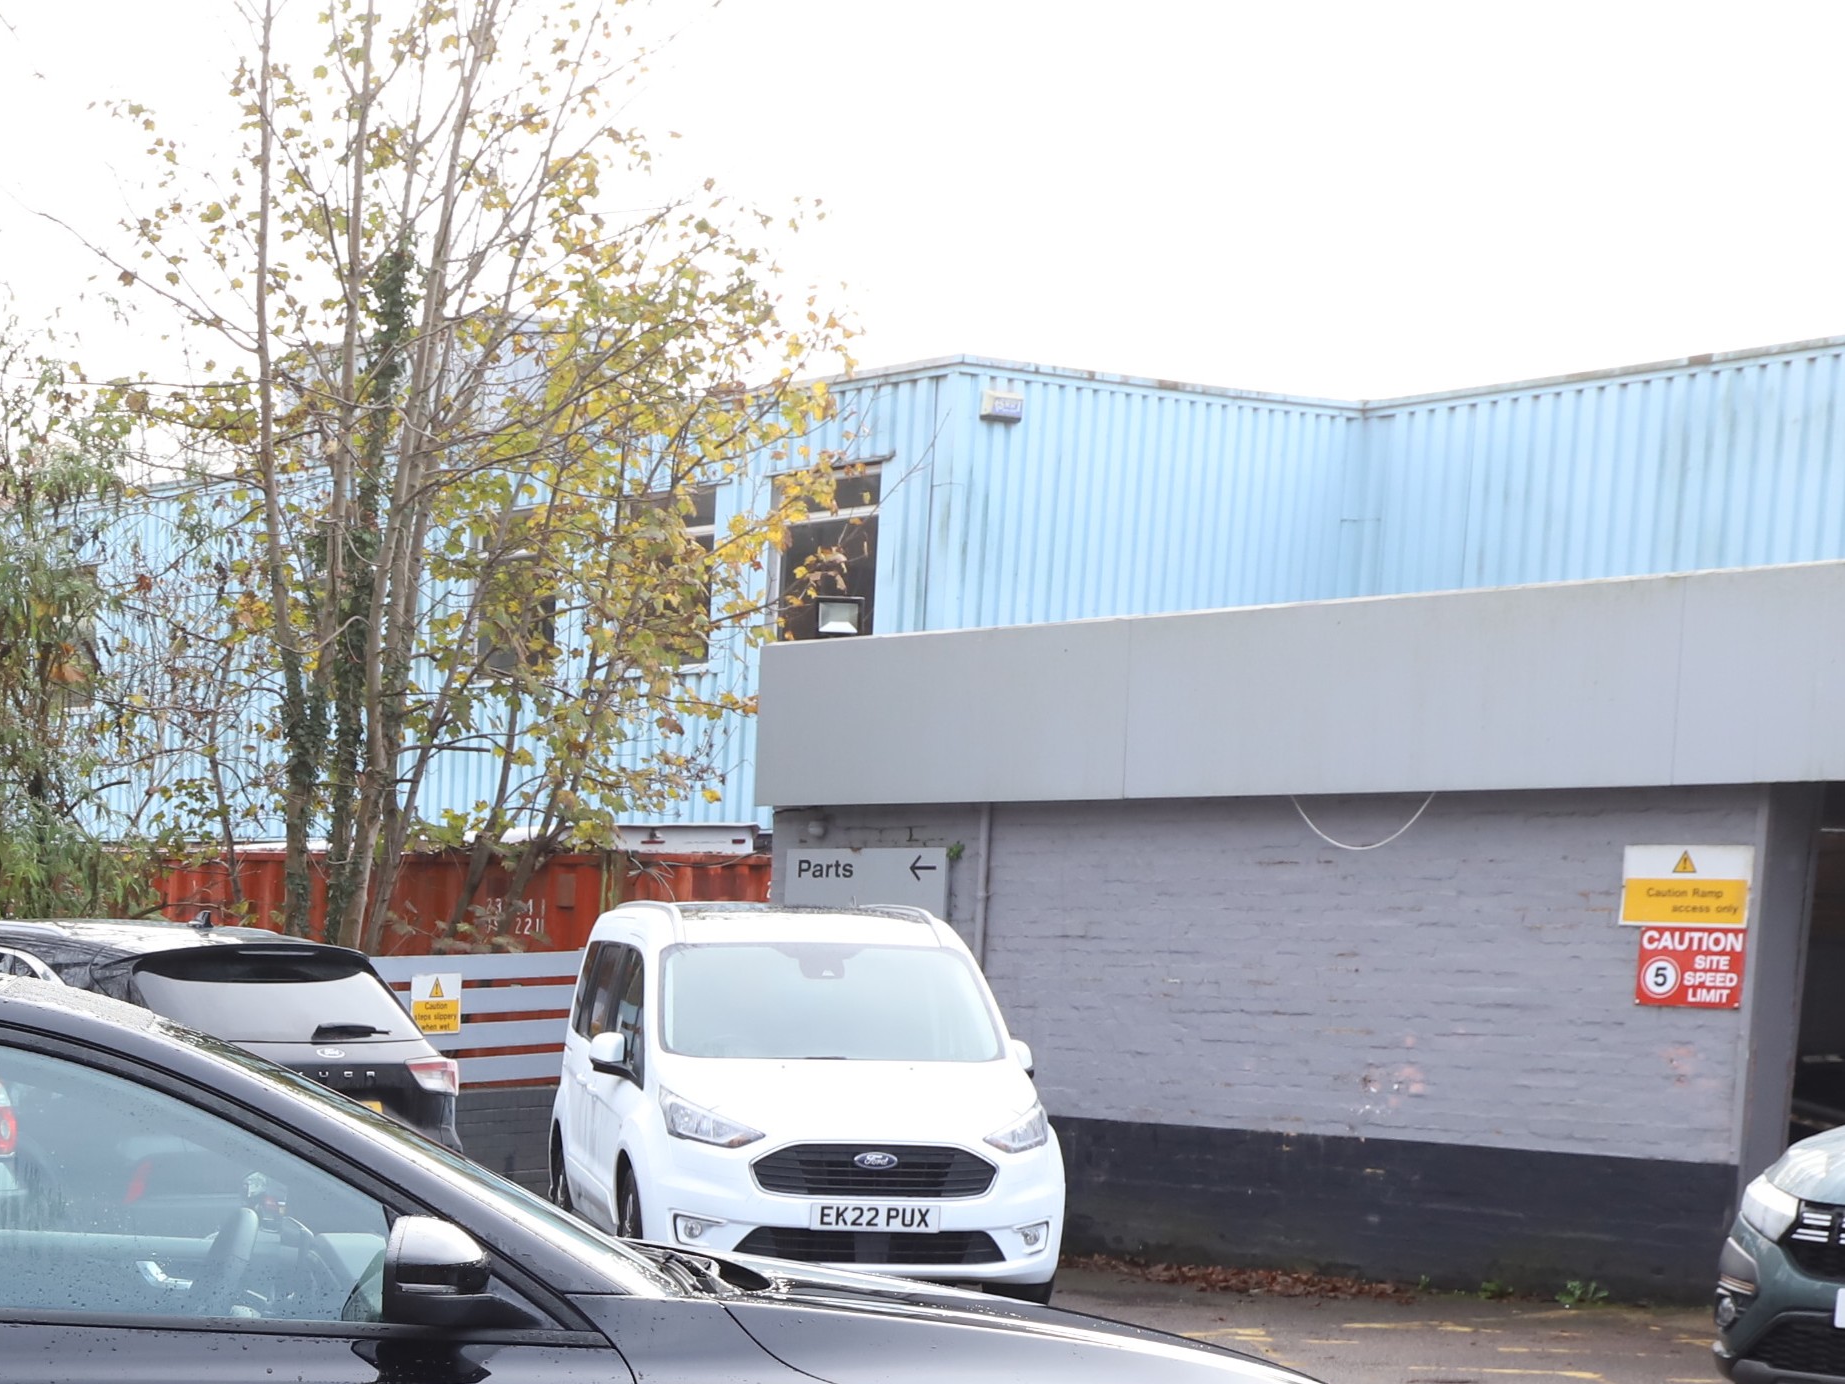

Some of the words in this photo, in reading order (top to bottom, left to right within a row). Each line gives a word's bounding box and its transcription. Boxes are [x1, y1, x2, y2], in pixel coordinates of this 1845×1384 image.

[798, 859, 854, 879] Parts
[1646, 887, 1688, 898] Caution
[1692, 888, 1724, 899] Ramp
[1671, 904, 1711, 913] access
[1716, 905, 1739, 915] only
[1642, 930, 1744, 952] CAUTION
[1694, 955, 1730, 970] SITE
[1653, 966, 1668, 987] 5
[1683, 972, 1738, 987] SPEED
[1687, 988, 1730, 1003] LIMIT
[425, 1002, 448, 1010] Caution
[434, 1012, 457, 1021] slippery
[864, 1154, 889, 1165] Ford
[819, 1205, 880, 1227] EK22
[886, 1207, 930, 1228] PUX
